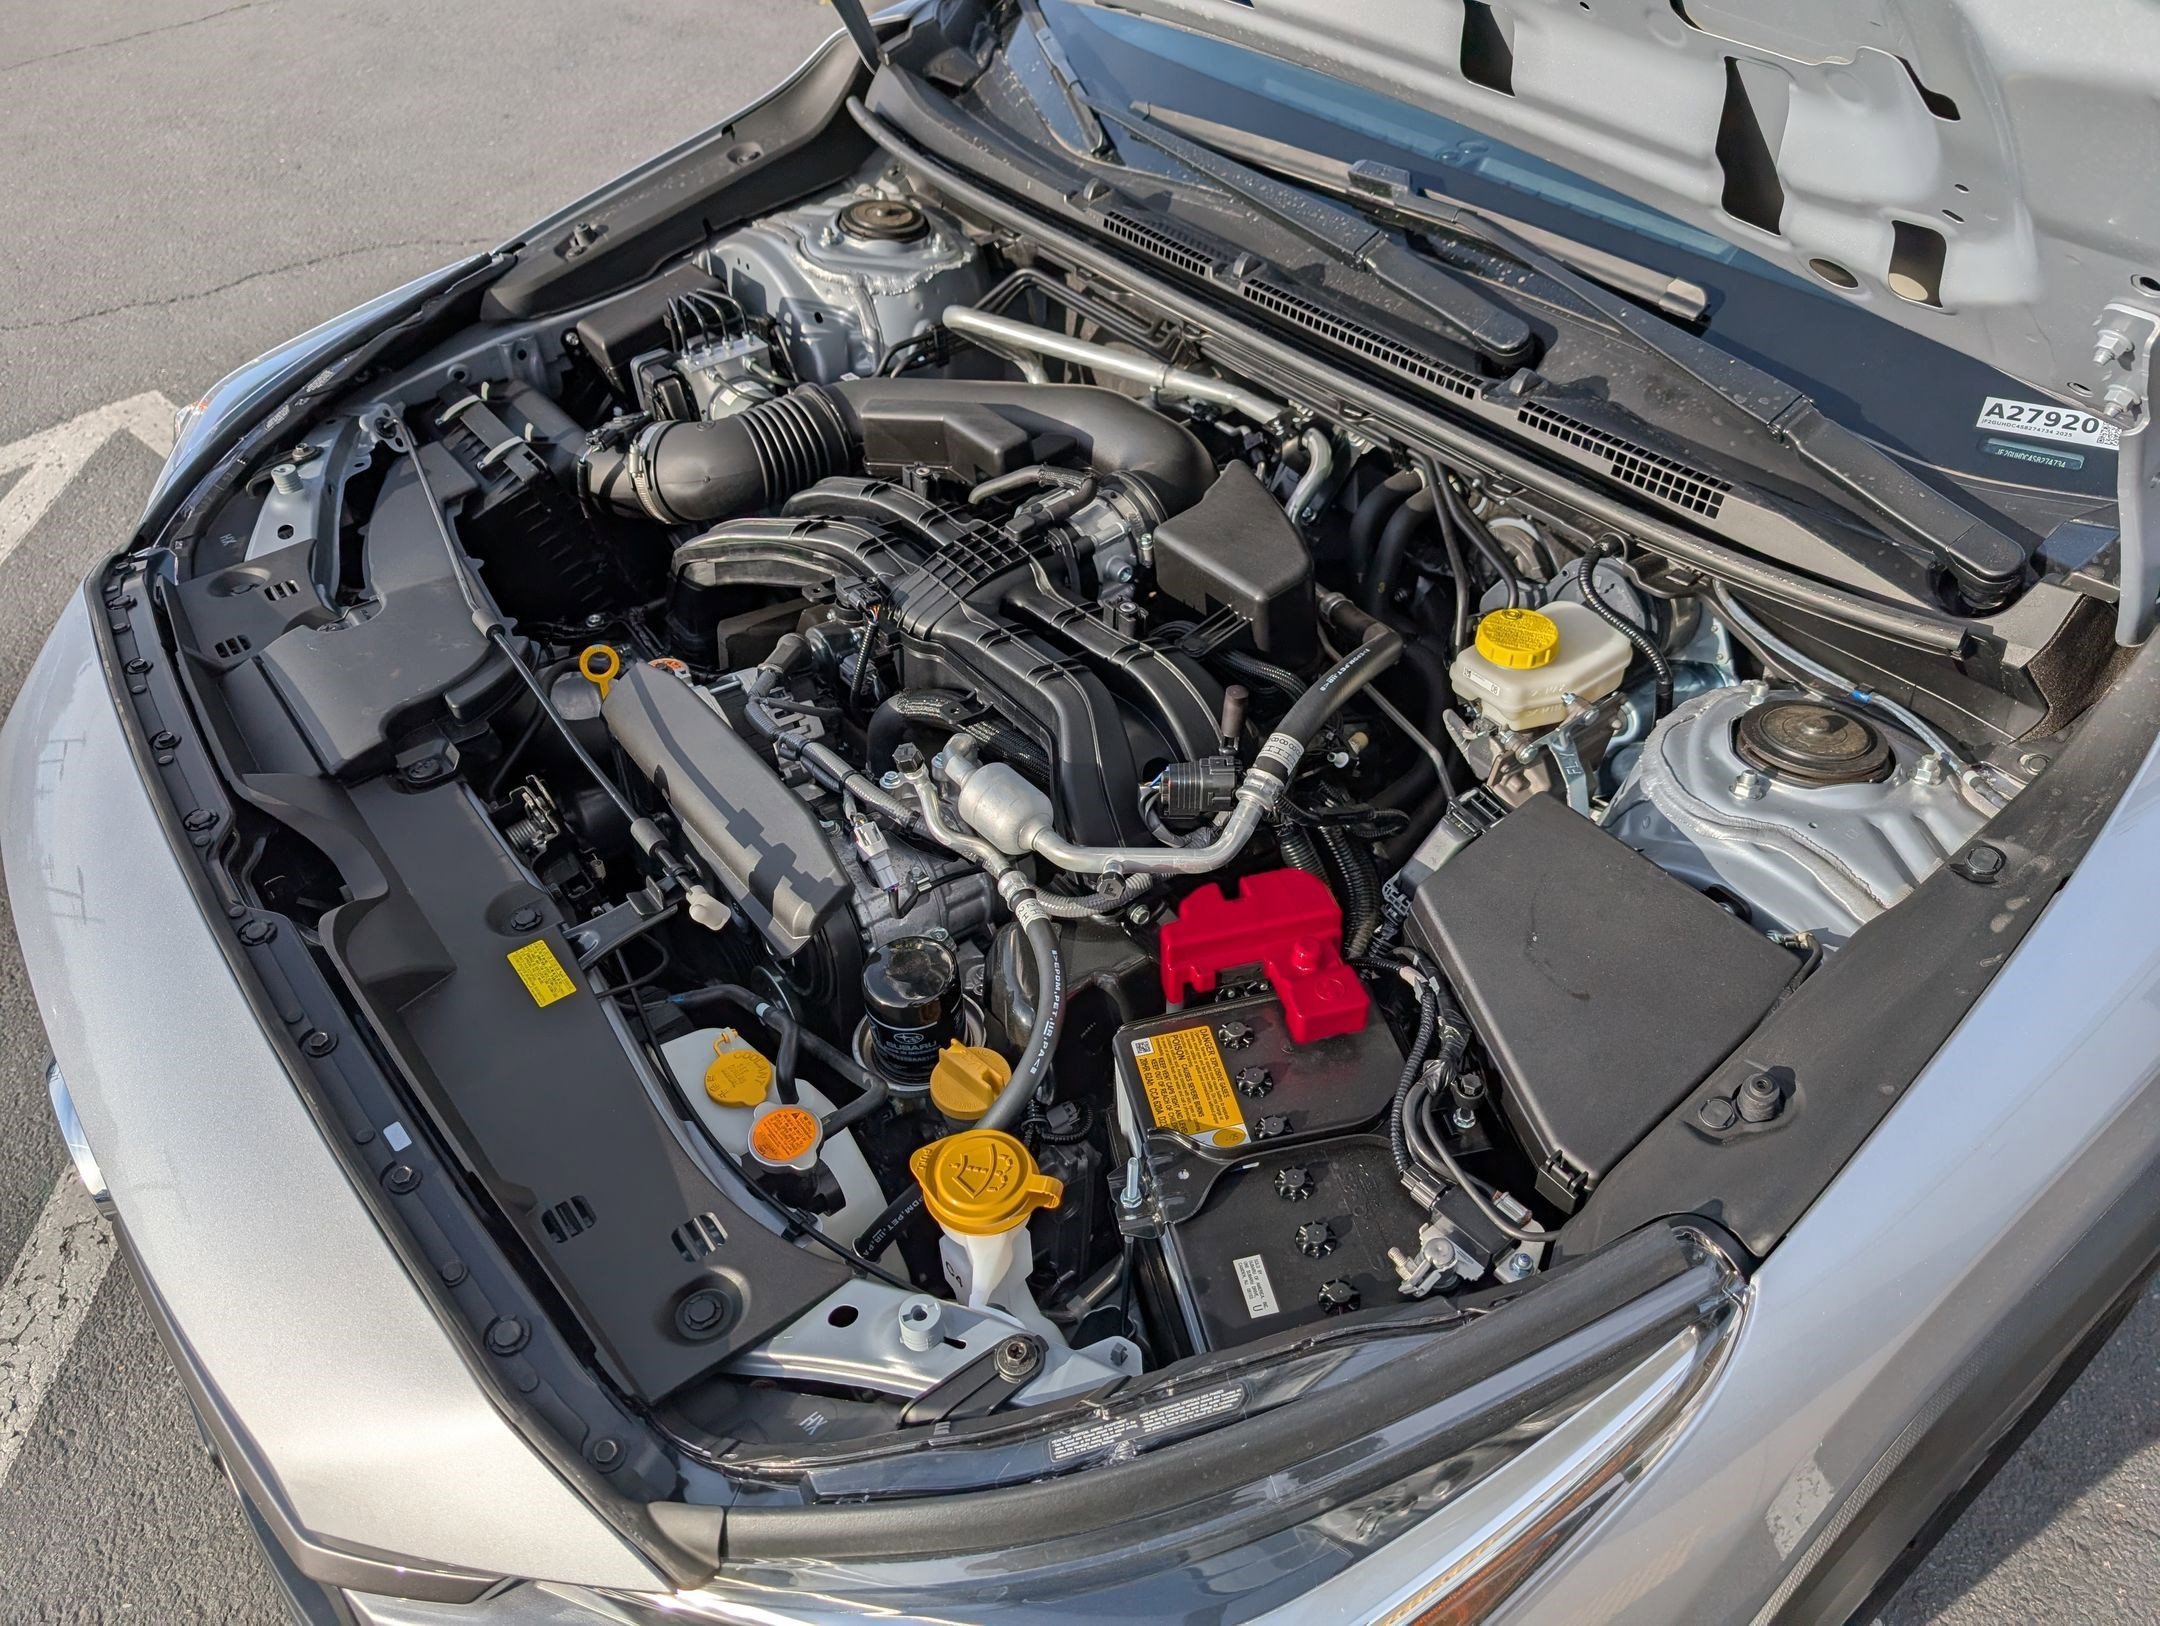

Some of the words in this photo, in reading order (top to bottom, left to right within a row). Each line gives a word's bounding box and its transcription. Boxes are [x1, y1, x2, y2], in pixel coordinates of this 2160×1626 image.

[1984, 401, 2100, 434] A27920
[885, 1039, 936, 1051] SUBARU
[1151, 1058, 1159, 1070] KEEP
[1158, 1057, 1167, 1069] KEEP
[1199, 1028, 1215, 1055] DANGER
[1210, 1057, 1224, 1081] EXPLOSIVE
[1219, 1082, 1230, 1097] GASES
[1154, 1071, 1163, 1080] OUT
[1162, 1069, 1171, 1080] VENT
[1170, 1034, 1185, 1060] POISON
[1181, 1063, 1192, 1082] CAUSES
[1187, 1082, 1199, 1100] SEVERE
[1194, 1101, 1204, 1117] BURNS
[1149, 1088, 1159, 1100] CCA
[1165, 1082, 1175, 1094] CAPS
[1160, 1088, 1170, 1104] REACH
[1171, 1094, 1180, 1108] TIGHT
[1175, 1109, 1183, 1119] AND
[798, 1411, 828, 1435] HX
